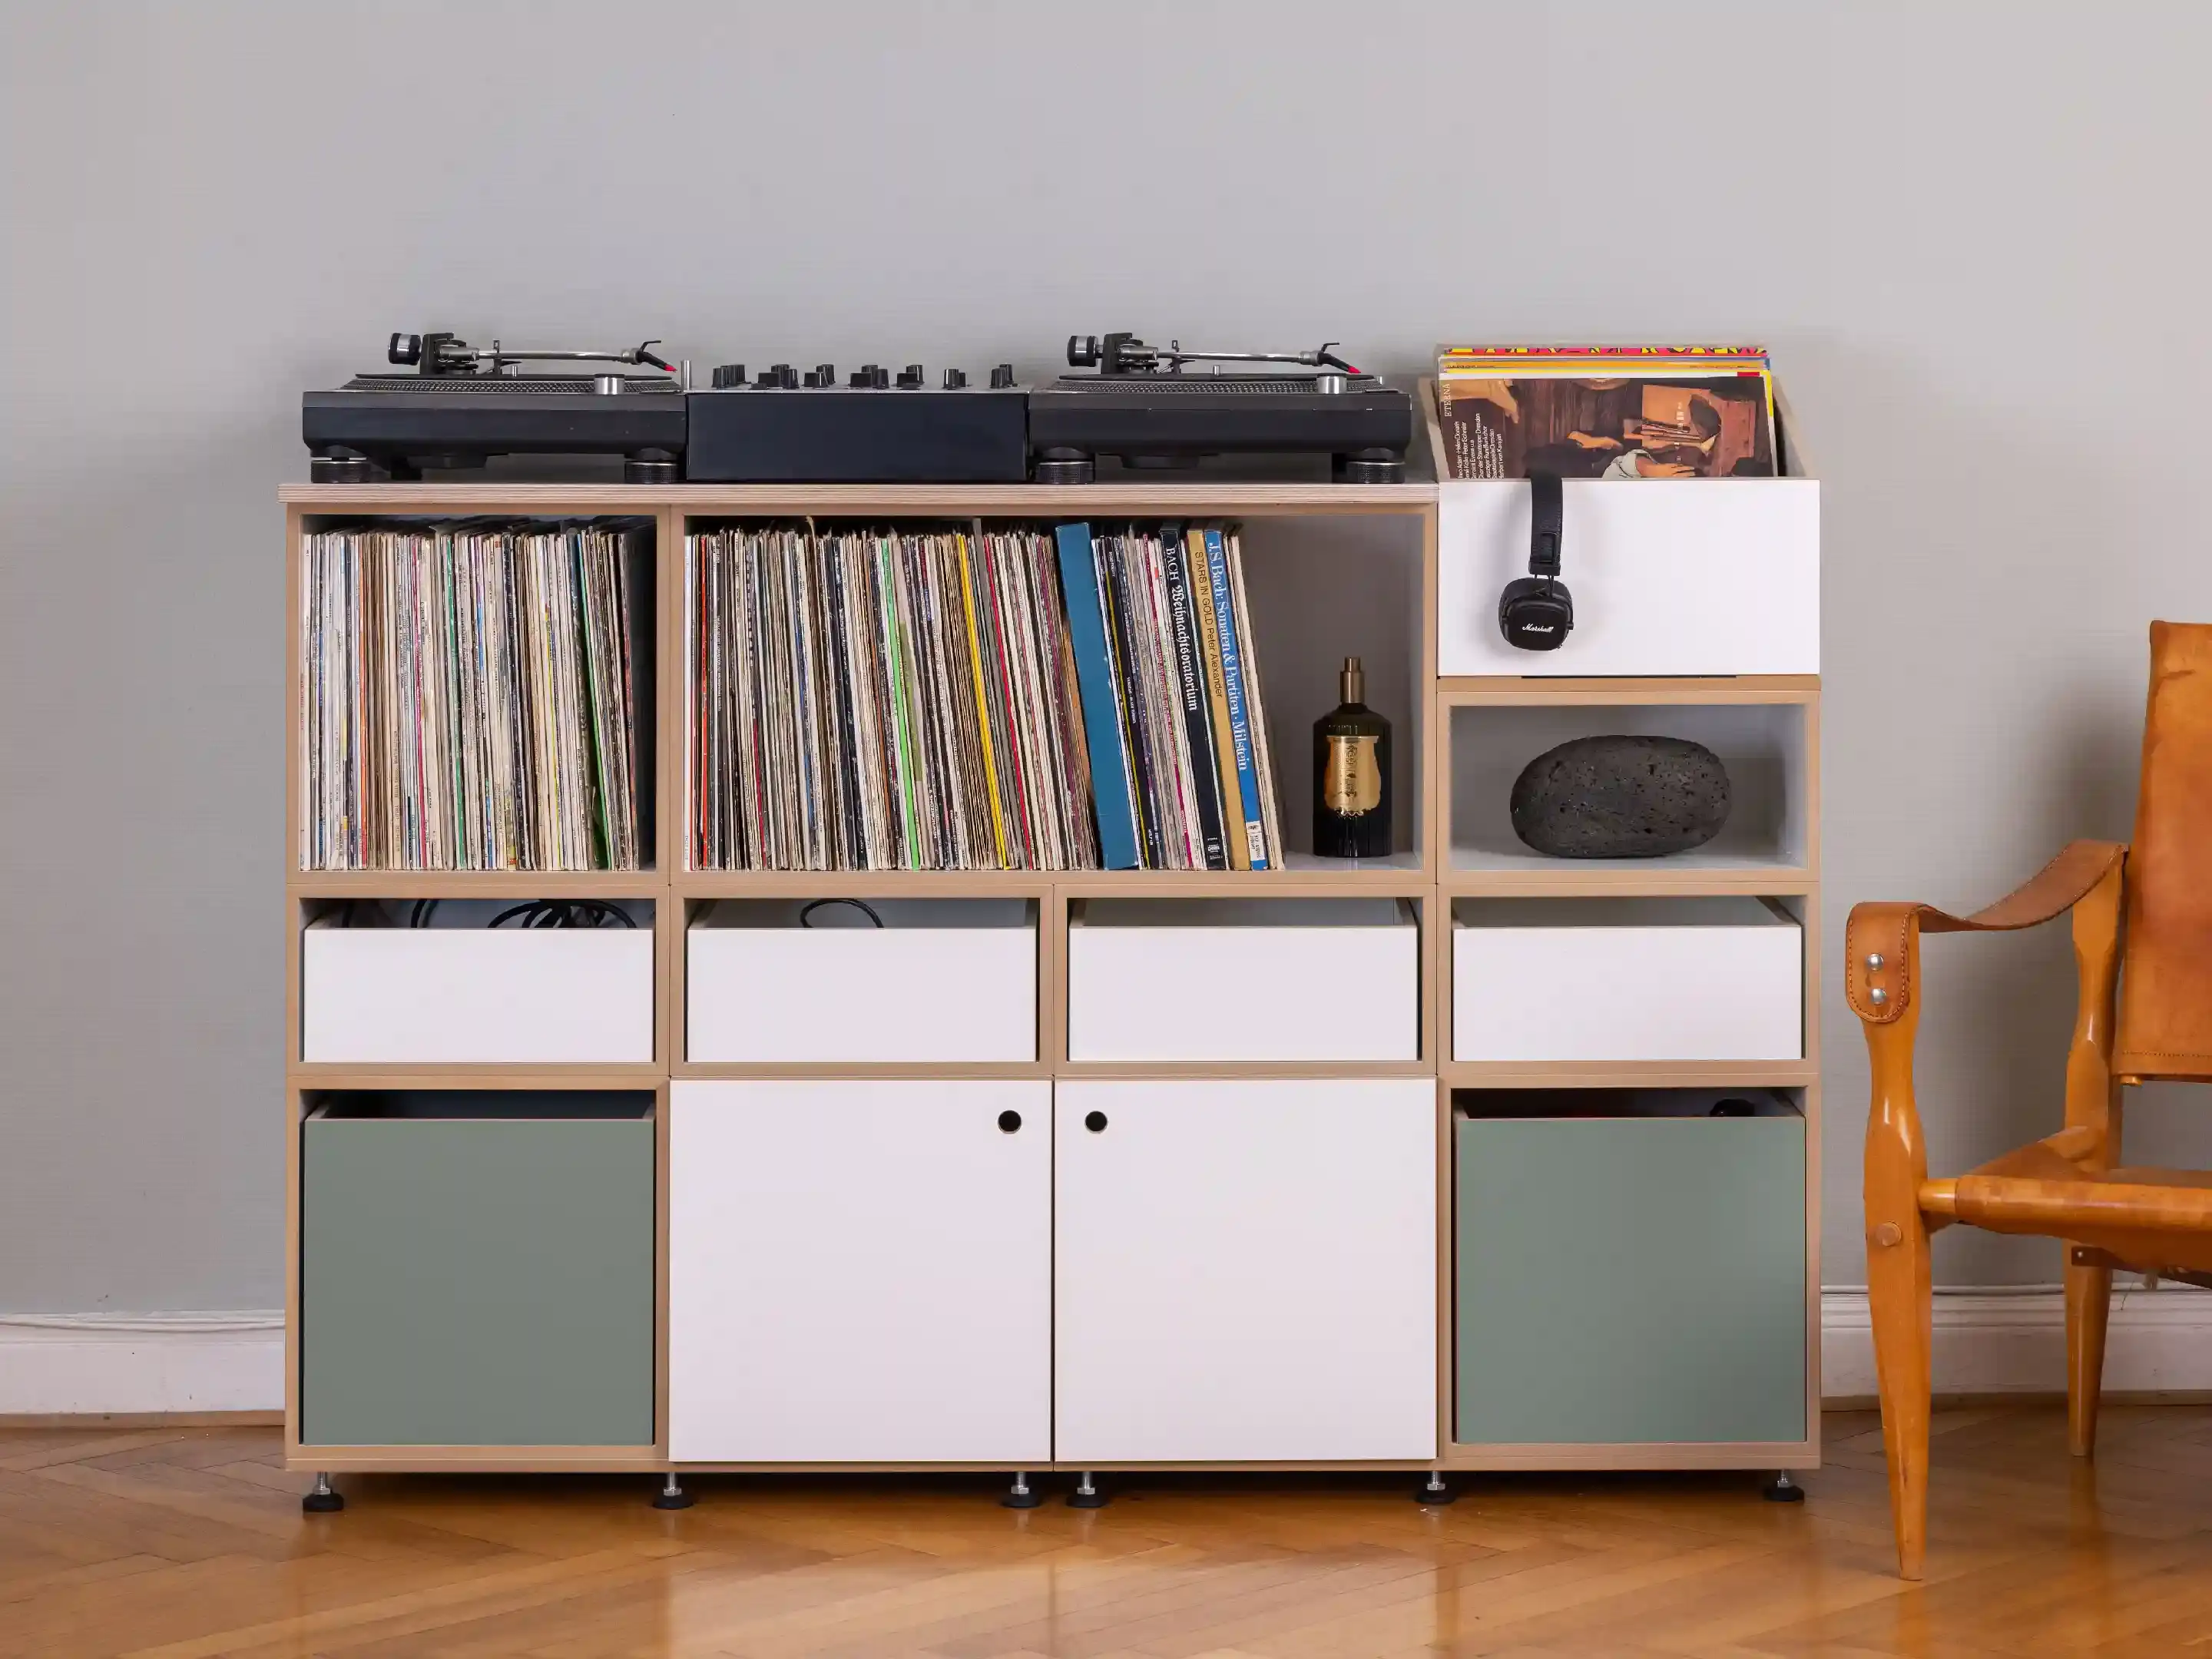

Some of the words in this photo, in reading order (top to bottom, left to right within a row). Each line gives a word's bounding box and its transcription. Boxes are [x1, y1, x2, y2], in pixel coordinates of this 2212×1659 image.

[1443, 383, 1452, 416] ETERNA
[1165, 547, 1180, 581] BACH
[1195, 551, 1207, 584] STARS
[1200, 585, 1208, 595] IN
[1211, 565, 1227, 600] Bach:
[1202, 598, 1214, 625] GOLD
[1217, 601, 1231, 653] Sonaten
[1522, 623, 1555, 633] Marshall
[1171, 584, 1198, 710] Weihnachtsoratorium
[1223, 654, 1236, 664] &
[1210, 654, 1223, 697] Alexander
[1225, 666, 1240, 716] Partiten
[1232, 720, 1250, 770] Milstein
